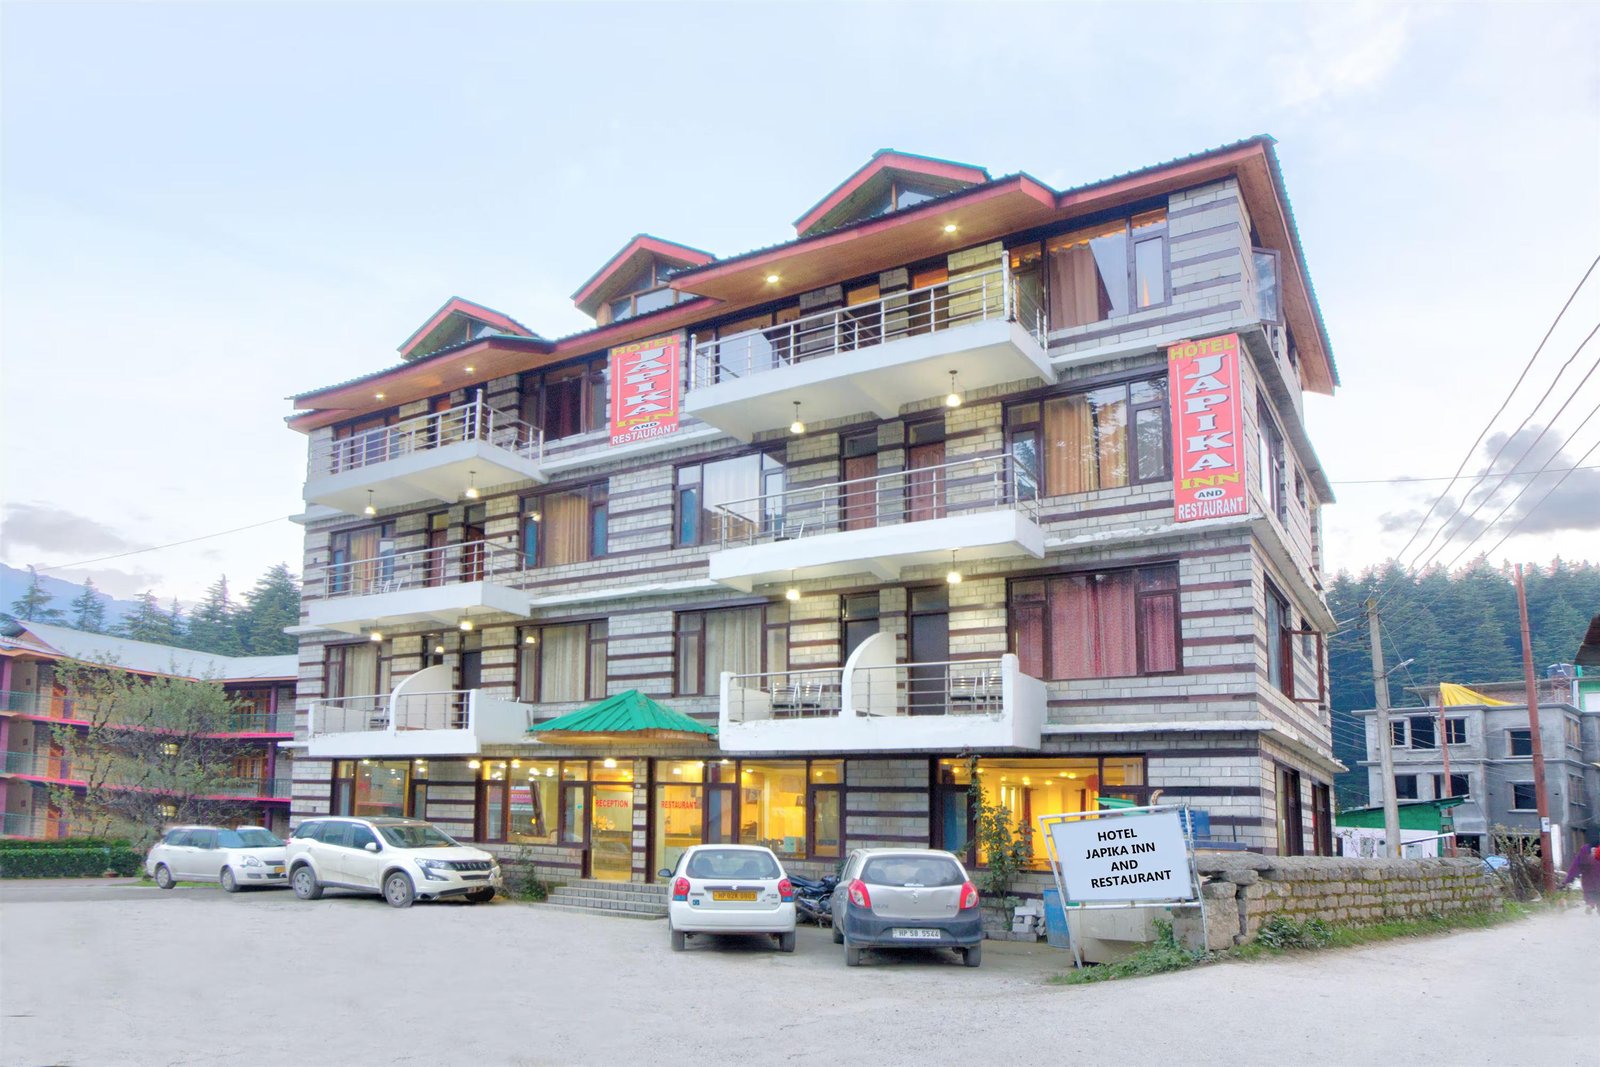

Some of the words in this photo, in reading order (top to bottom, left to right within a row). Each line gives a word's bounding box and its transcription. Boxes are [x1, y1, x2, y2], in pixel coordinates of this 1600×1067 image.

[612, 337, 677, 356] HOTEL
[1170, 337, 1236, 361] HOTEL
[624, 346, 671, 417] JAPIKA
[617, 410, 674, 427] INN
[1184, 354, 1234, 472] JAPIKA
[612, 423, 678, 445] RESTAURANT
[632, 422, 657, 430] AND
[1181, 471, 1240, 490] INN
[1197, 489, 1223, 499] AND
[1178, 497, 1243, 520] RESTAURANT
[595, 799, 628, 808] RECEPTION
[661, 800, 697, 809] RESTAURANT
[1098, 828, 1137, 841] HOTEL
[1086, 845, 1129, 860] JAPIKA
[1131, 842, 1156, 854] INN
[1111, 860, 1138, 871] AND
[1091, 870, 1171, 888] RESTAURANT
